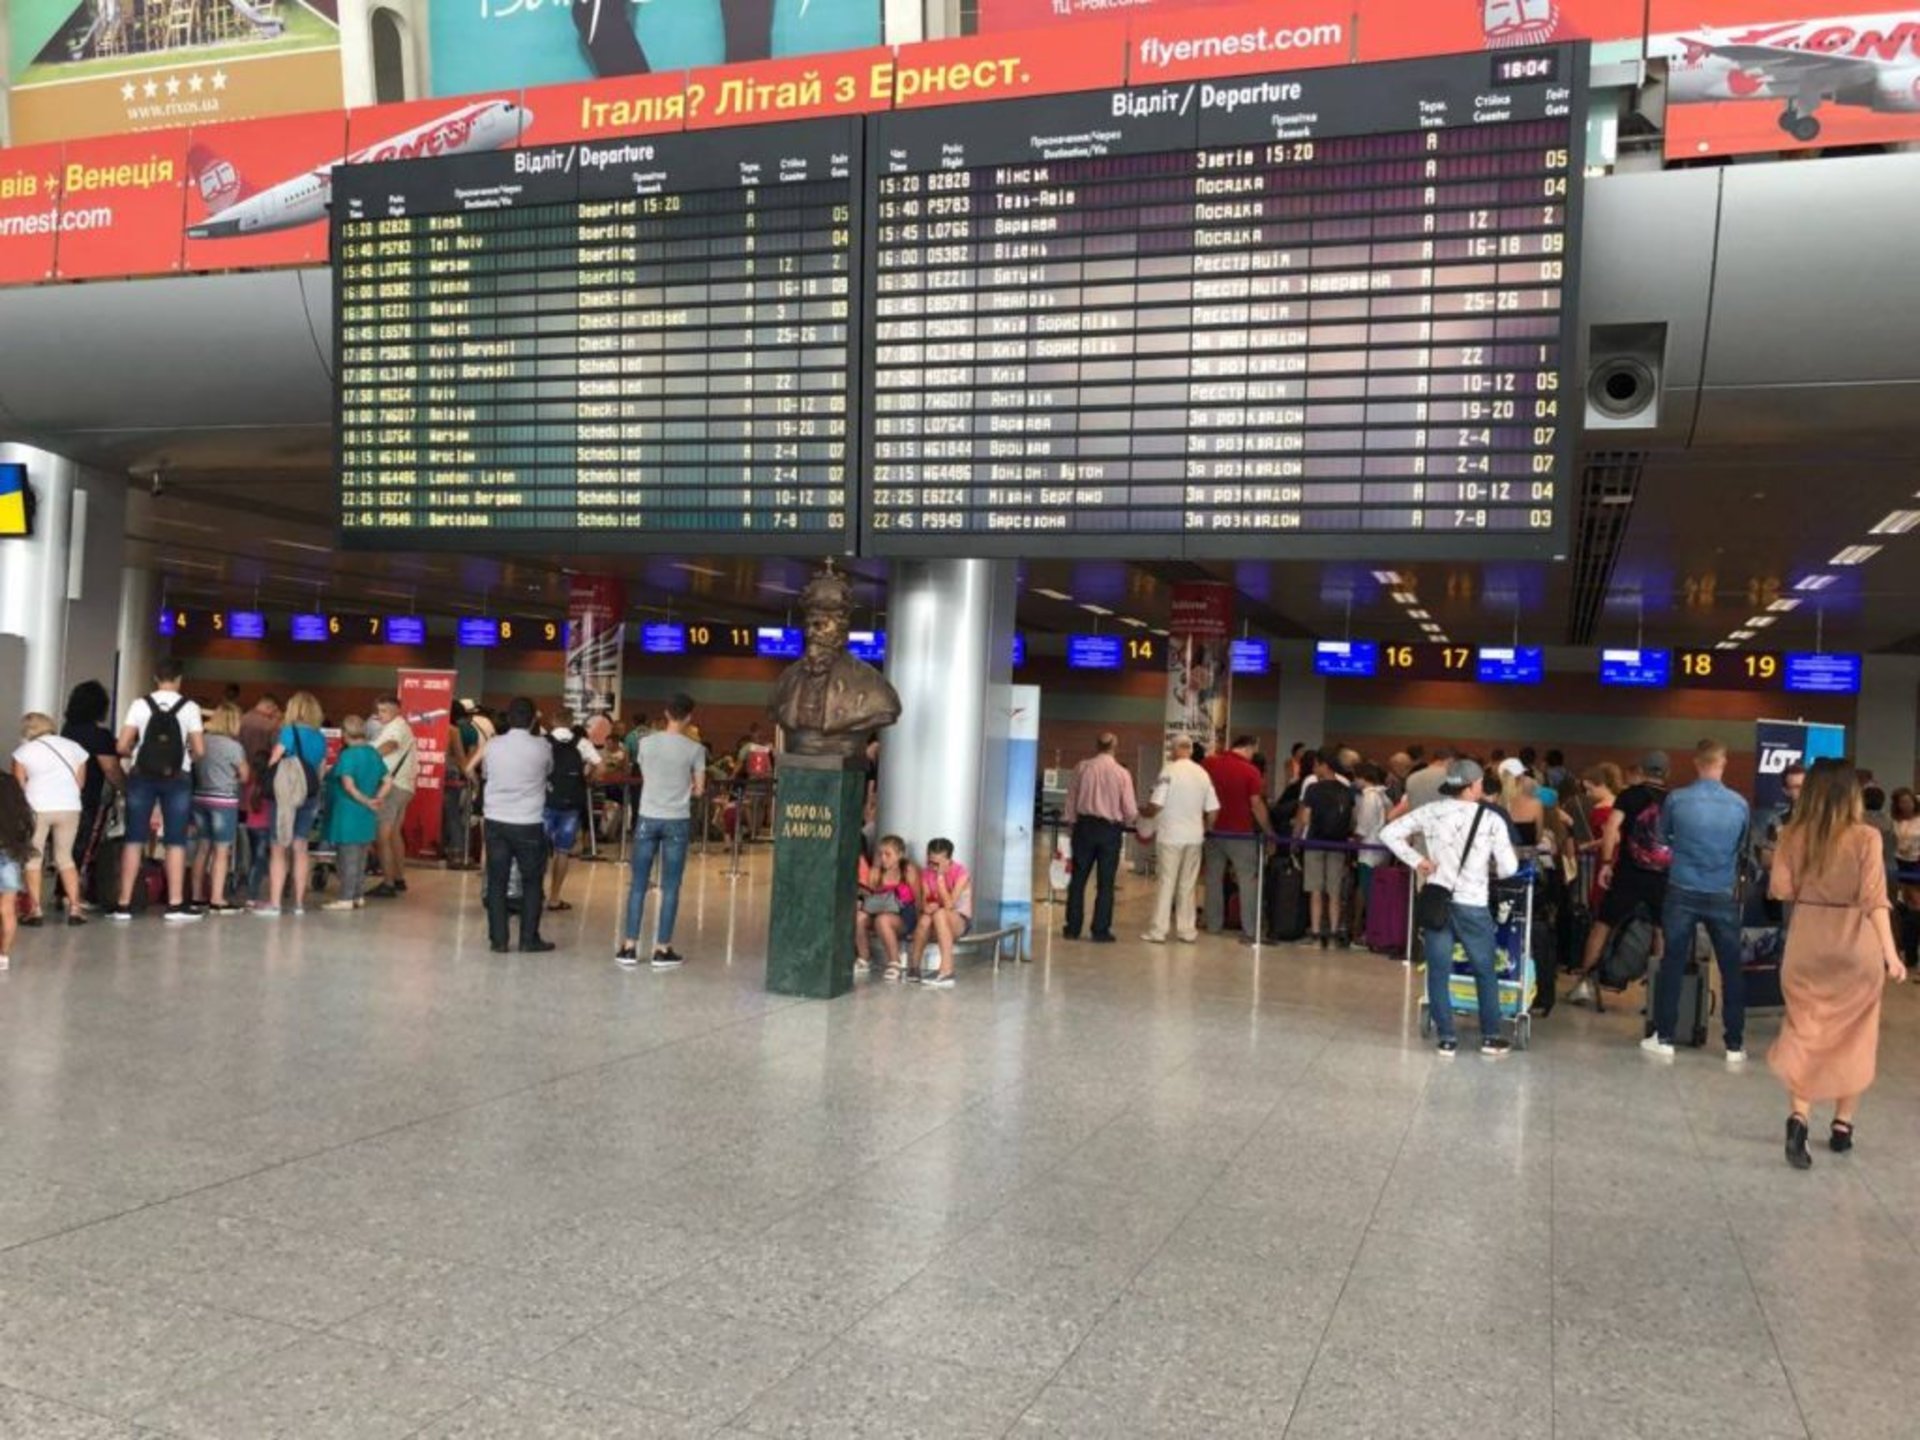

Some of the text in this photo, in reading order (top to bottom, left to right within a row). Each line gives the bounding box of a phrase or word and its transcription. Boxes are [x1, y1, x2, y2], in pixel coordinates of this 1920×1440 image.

[1140, 23, 1342, 66] flyernest.com
[581, 56, 1031, 130] Італія? Літай з Ернест.
[1200, 82, 1302, 111] Departure
[579, 144, 654, 170] Departure
[1266, 143, 1314, 163] 15:20
[65, 155, 173, 192] Венеція
[1468, 211, 1488, 229] 12
[1460, 374, 1515, 392] 10-12
[1459, 401, 1514, 419] 19-20
[1457, 429, 1491, 446] 2-4
[1456, 456, 1489, 472] 2-4
[1456, 482, 1511, 499] 10-12
[177, 613, 187, 628] 4
[213, 614, 223, 630] 5
[330, 618, 340, 634] 6
[370, 619, 379, 635] 7
[501, 622, 511, 639] 8
[545, 624, 555, 640] 9
[690, 627, 709, 644] 10
[731, 630, 750, 646] 11
[1129, 639, 1153, 660] 14
[1387, 647, 1413, 667] 16
[1442, 648, 1470, 669] 17
[1682, 654, 1711, 675] 18
[1745, 656, 1776, 677] 19
